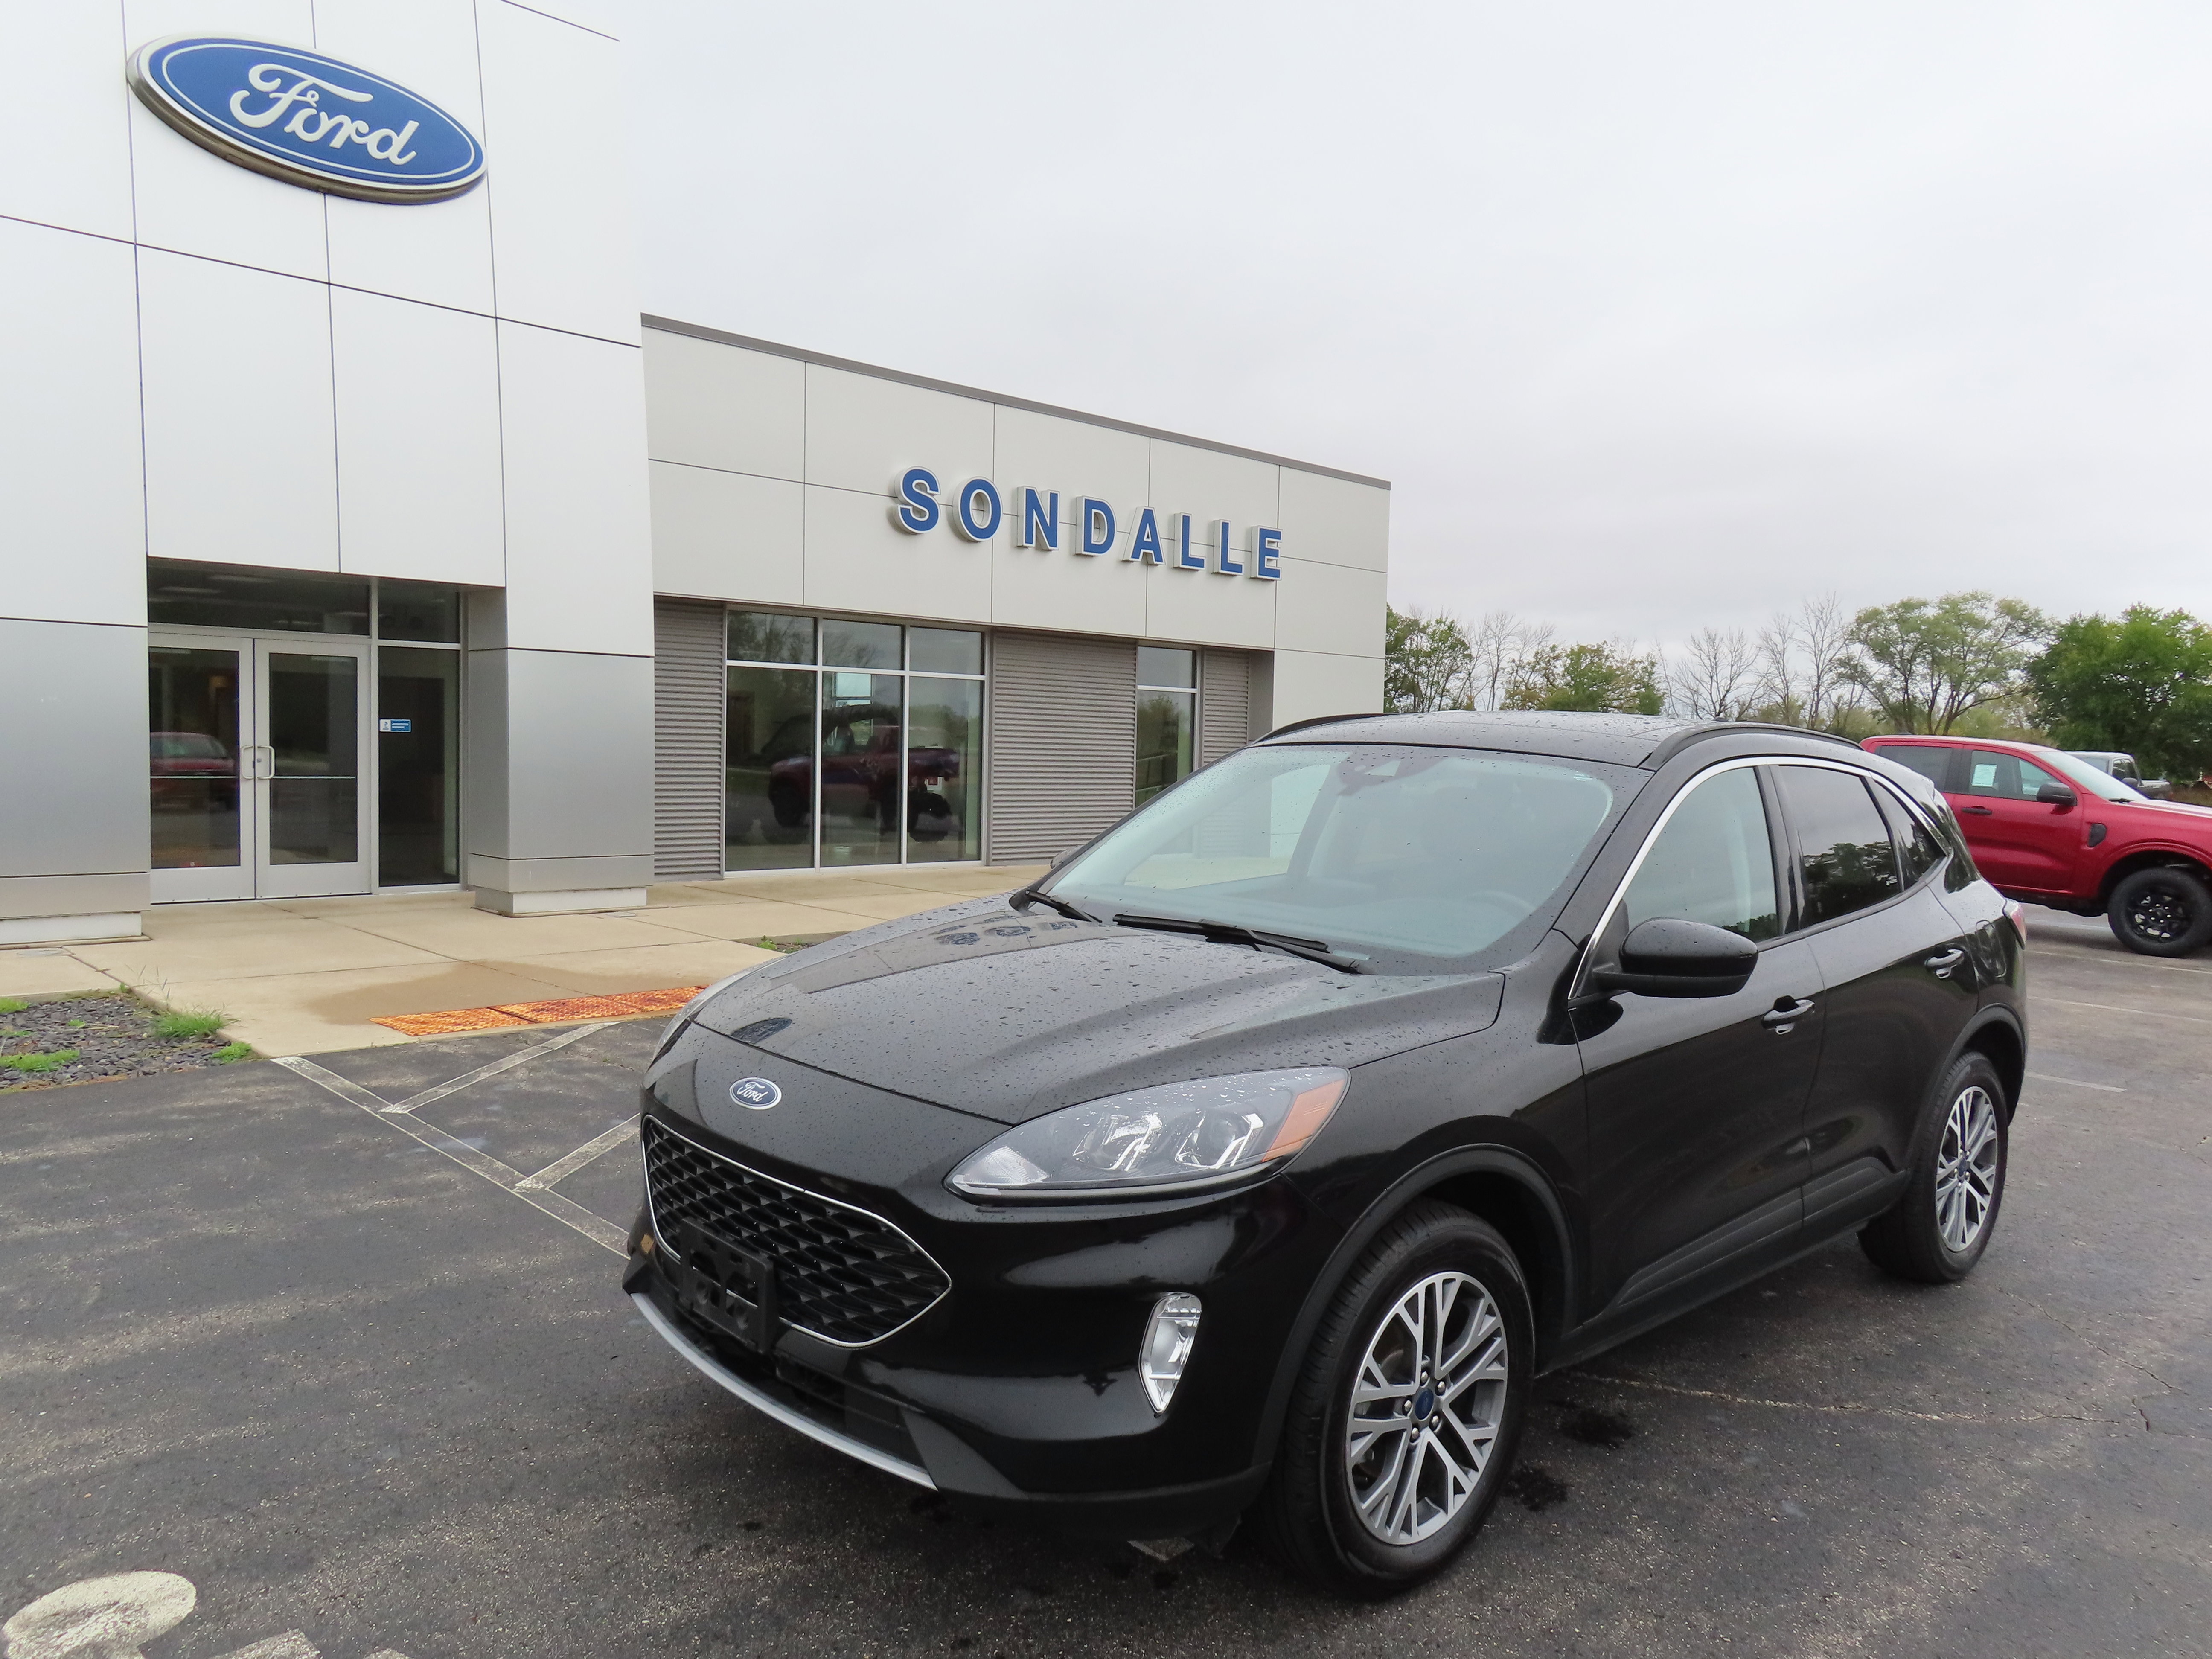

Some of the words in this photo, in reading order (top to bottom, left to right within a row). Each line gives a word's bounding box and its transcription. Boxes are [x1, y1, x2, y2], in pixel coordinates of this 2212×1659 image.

[230, 64, 419, 165] Ford
[895, 467, 1282, 580] SONDALLE
[737, 1081, 768, 1102] Ford
